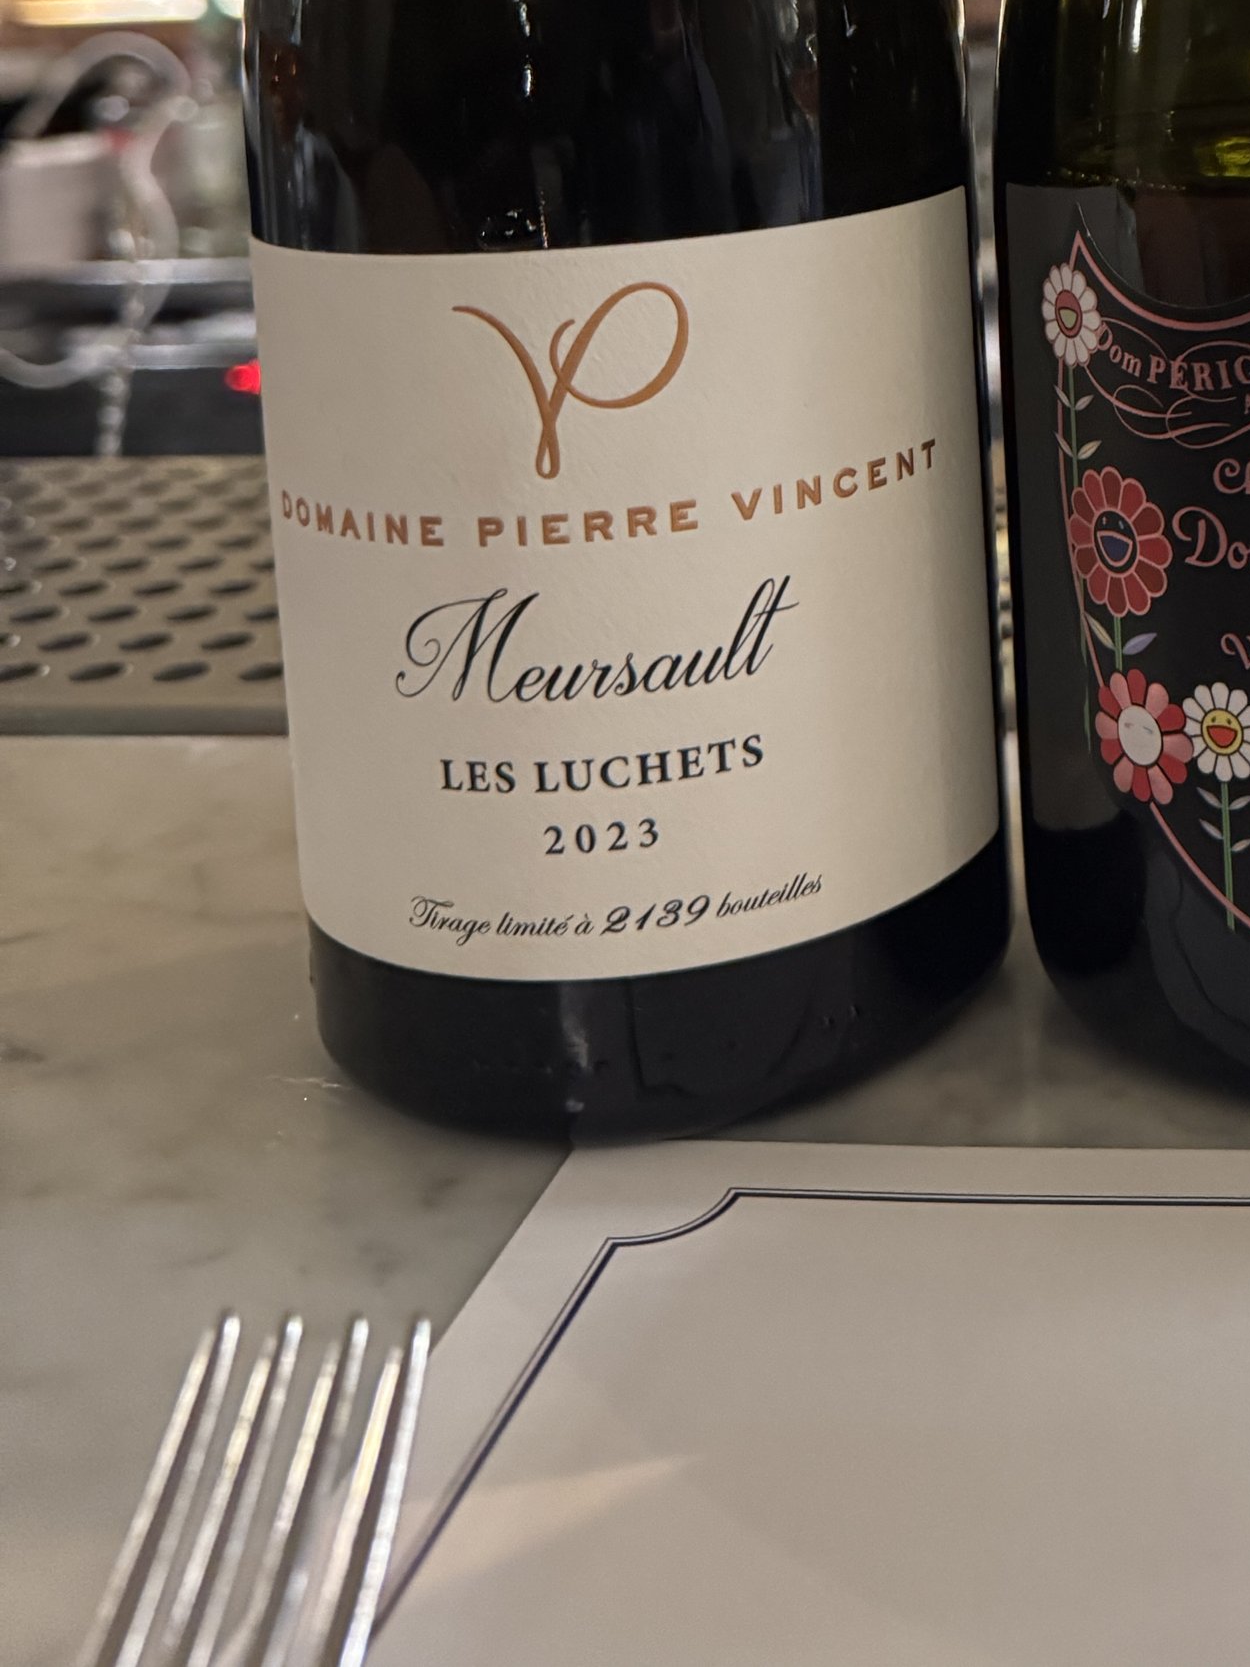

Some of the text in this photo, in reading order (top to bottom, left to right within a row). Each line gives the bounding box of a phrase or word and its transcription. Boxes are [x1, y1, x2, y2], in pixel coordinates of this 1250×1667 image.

[1097, 322, 1143, 378] Dom
[281, 438, 937, 548] DOMAINE PIERRE VINCENT
[395, 575, 800, 703] Meursault
[440, 735, 765, 794] LES LUCHETS
[543, 818, 662, 856] 2023
[408, 872, 823, 946] Tirage limité à 2139 bouteilles
